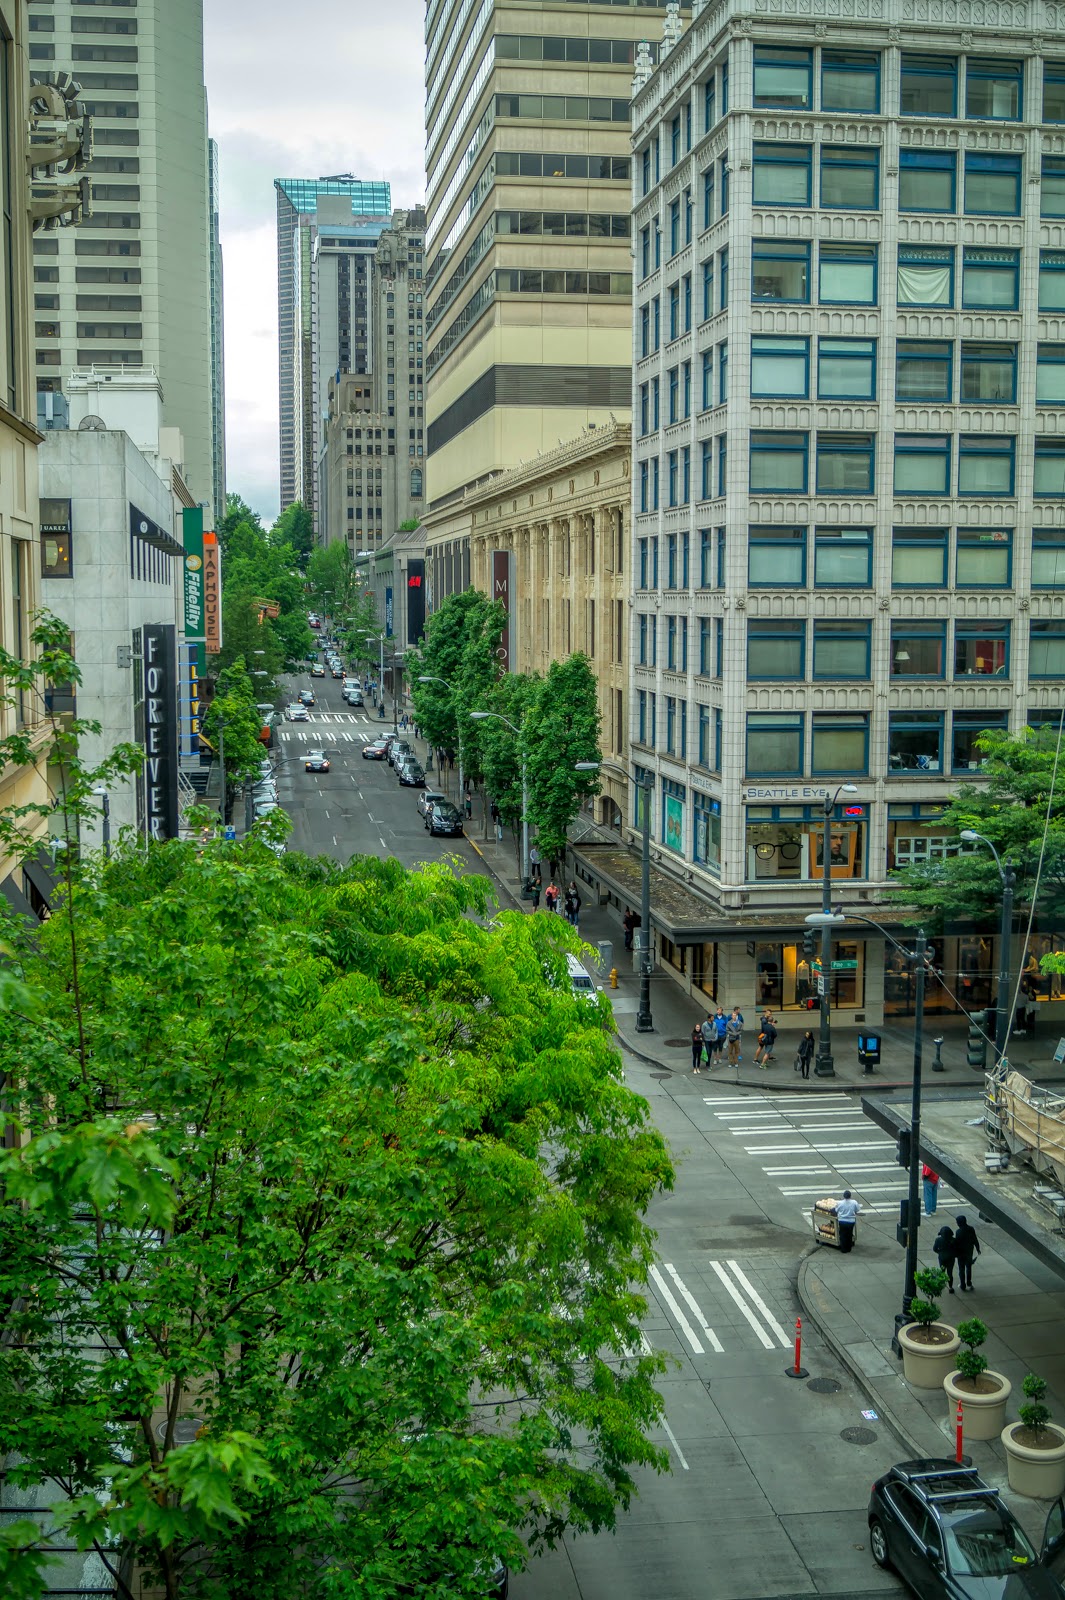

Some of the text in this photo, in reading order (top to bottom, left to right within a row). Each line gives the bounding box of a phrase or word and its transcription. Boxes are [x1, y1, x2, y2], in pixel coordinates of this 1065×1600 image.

[186, 571, 200, 630] Fidelity
[205, 549, 217, 636] TAPHOUSE
[495, 579, 508, 677] MIOS
[191, 665, 200, 734] LIVE
[147, 637, 163, 841] FOREVER
[747, 787, 826, 798] SEATTLE EYE
